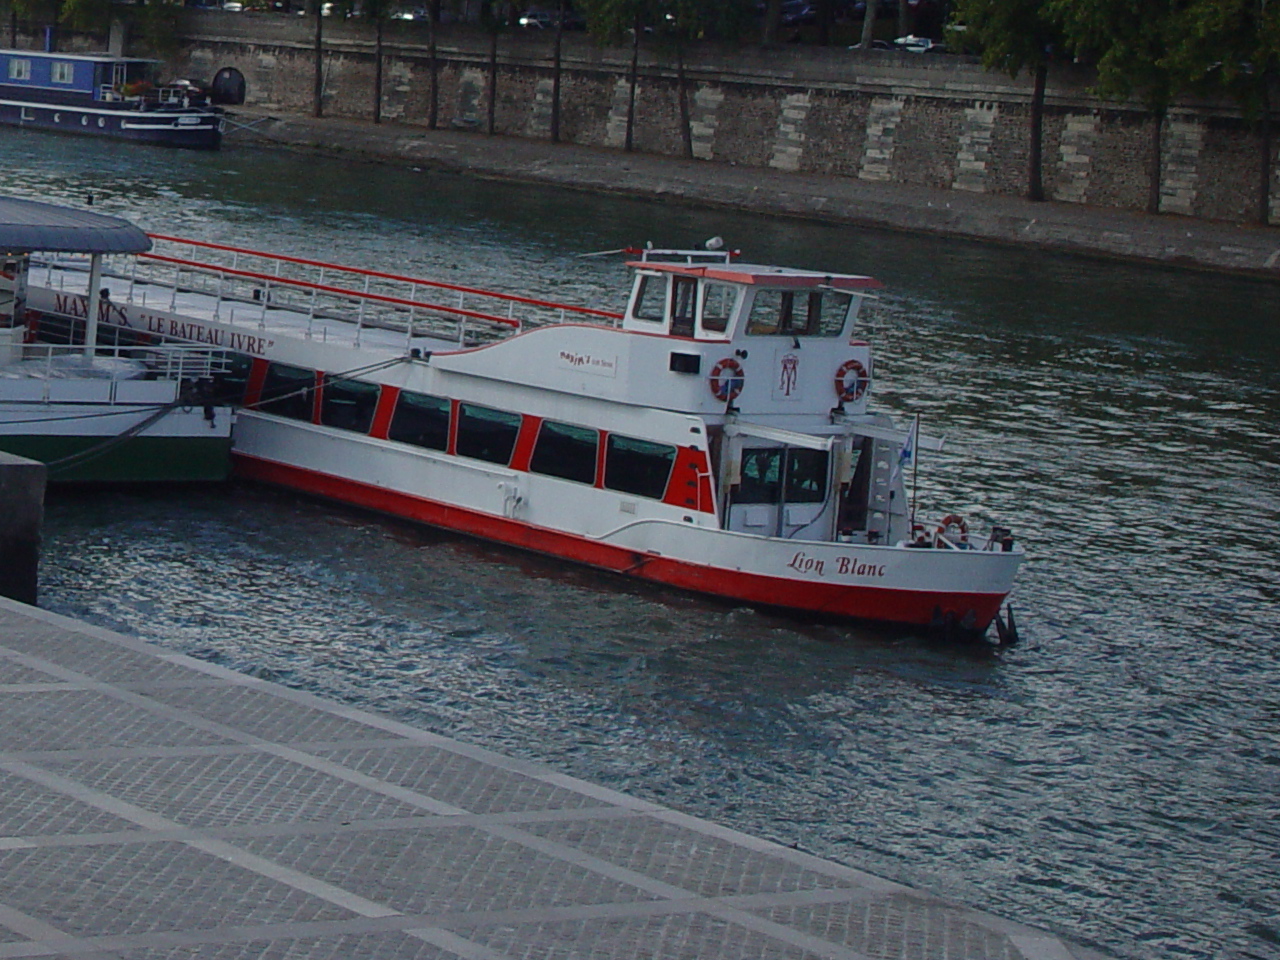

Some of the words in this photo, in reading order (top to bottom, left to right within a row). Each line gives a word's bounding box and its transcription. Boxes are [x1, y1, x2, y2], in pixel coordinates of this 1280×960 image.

[54, 293, 127, 327] MAXM'S
[169, 320, 225, 347] BATEAU
[786, 550, 825, 577] Lion
[835, 555, 887, 578] Blanc
